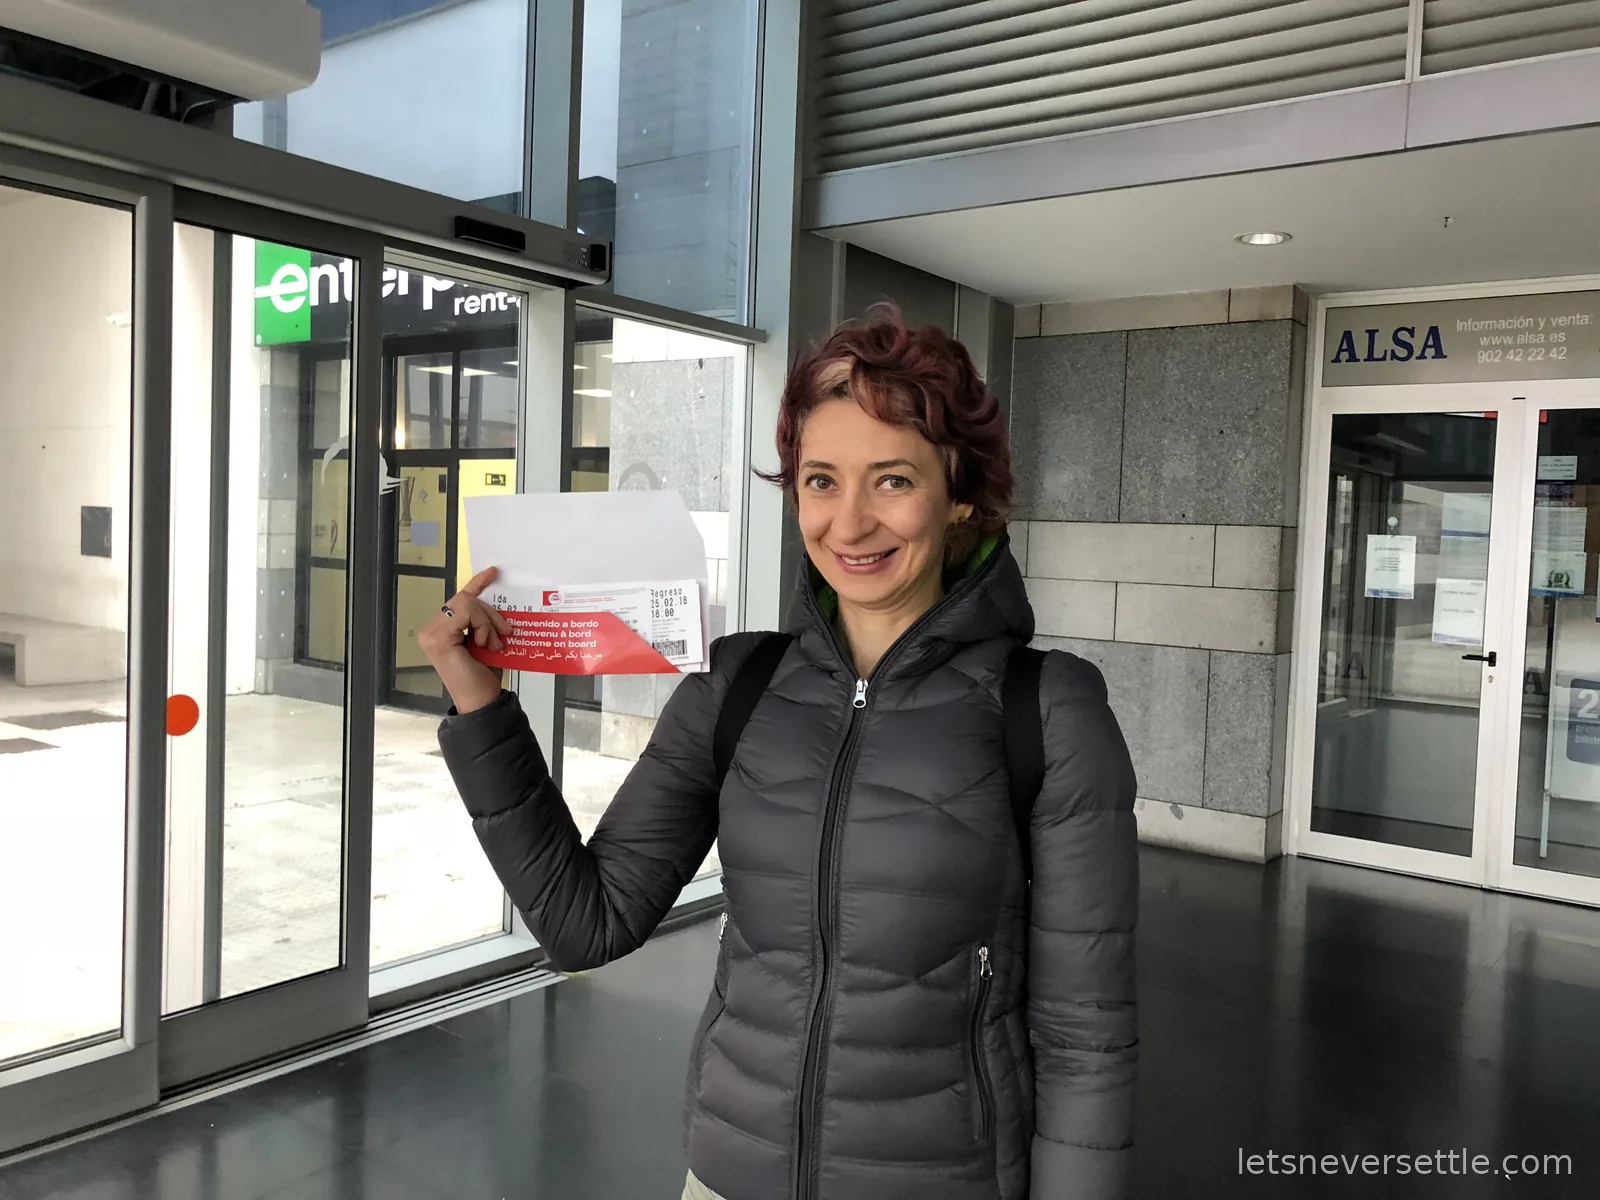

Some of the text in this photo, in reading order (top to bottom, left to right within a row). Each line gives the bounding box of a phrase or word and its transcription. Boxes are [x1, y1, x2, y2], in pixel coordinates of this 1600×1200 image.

[1456, 315, 1534, 333] Información
[1538, 317, 1547, 331] y
[1331, 325, 1448, 364] ALSA
[1479, 332, 1567, 346] www.alsa.es
[1477, 347, 1567, 363] 902 42 22 42
[493, 594, 507, 604] Ida
[650, 588, 683, 600] Regreso
[650, 596, 688, 609] 25.02.18
[651, 608, 675, 619] 18:00
[506, 618, 560, 628] Bienvenido
[570, 620, 599, 628] bordo
[513, 628, 558, 638] Bienvenu
[568, 629, 592, 638] bord
[506, 637, 552, 647] Welcome
[568, 639, 597, 648] board
